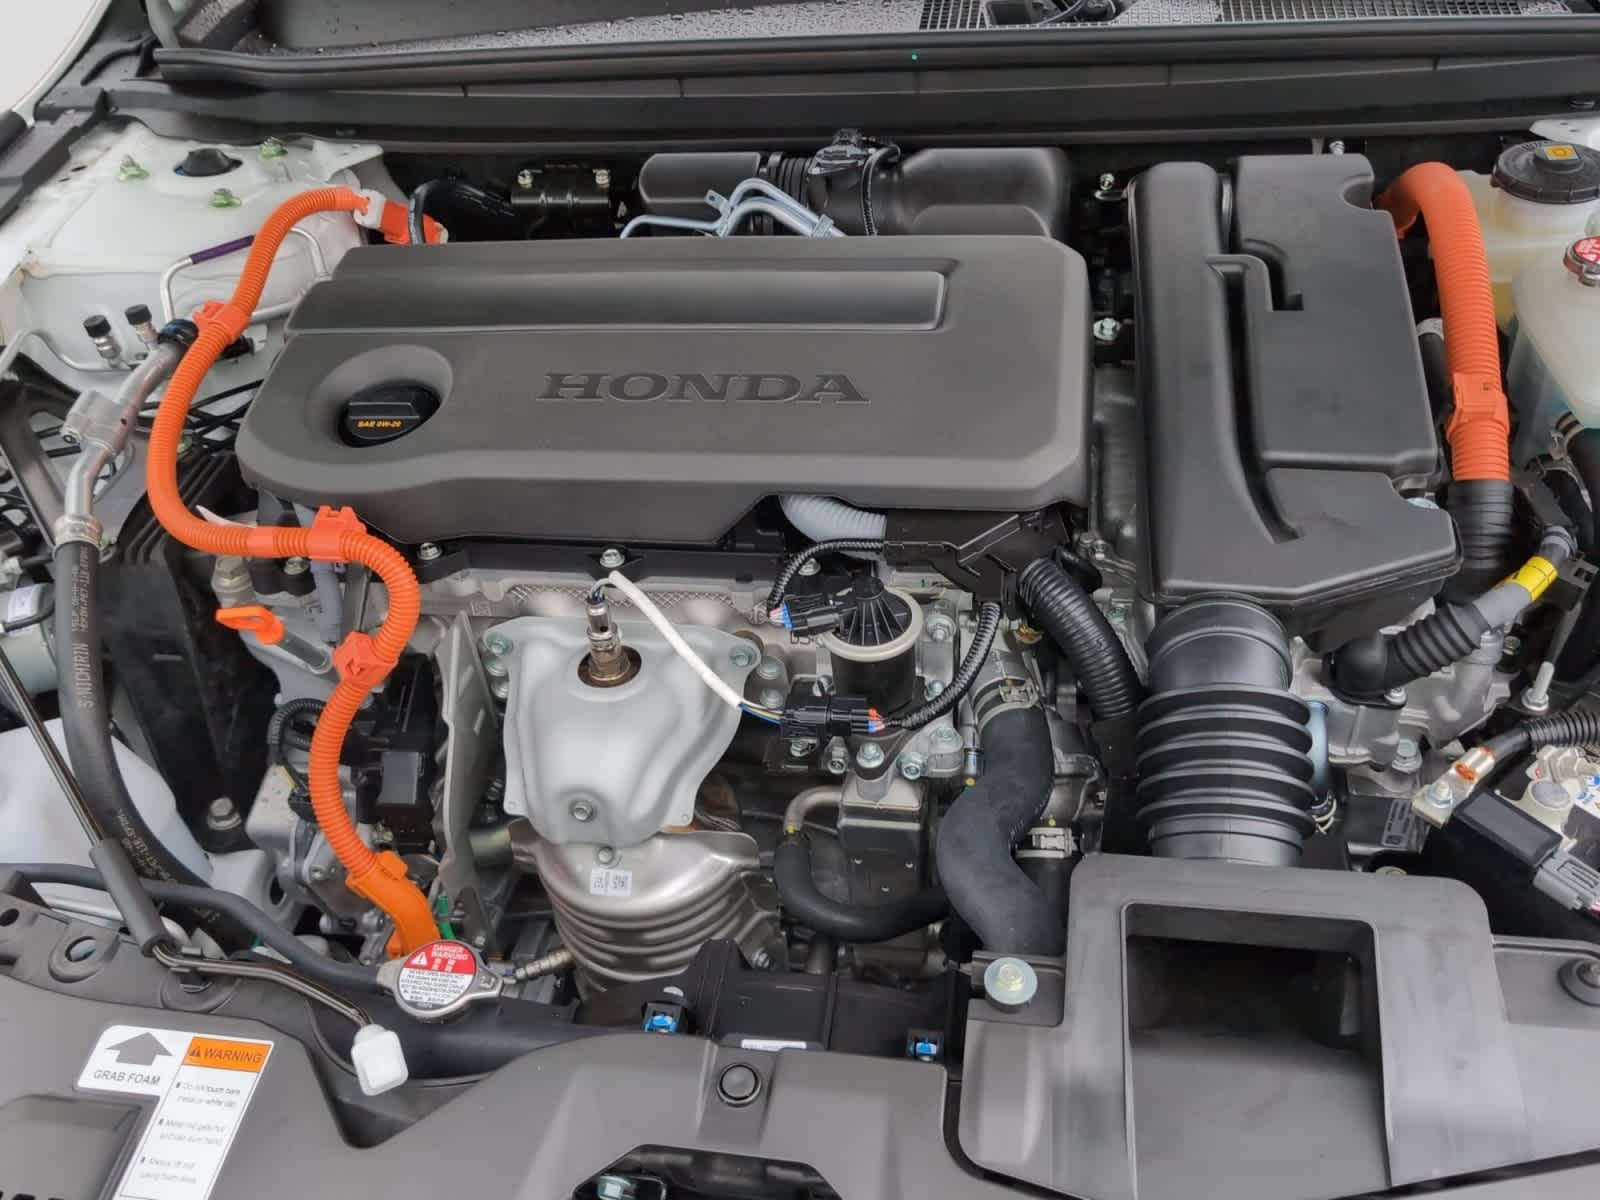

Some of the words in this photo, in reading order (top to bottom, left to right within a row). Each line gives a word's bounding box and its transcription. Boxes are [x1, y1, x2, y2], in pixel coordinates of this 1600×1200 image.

[536, 373, 871, 404] HONDA
[204, 1047, 262, 1063] WARNING
[93, 1069, 126, 1081] GRAB
[127, 1073, 161, 1086] FOAM
